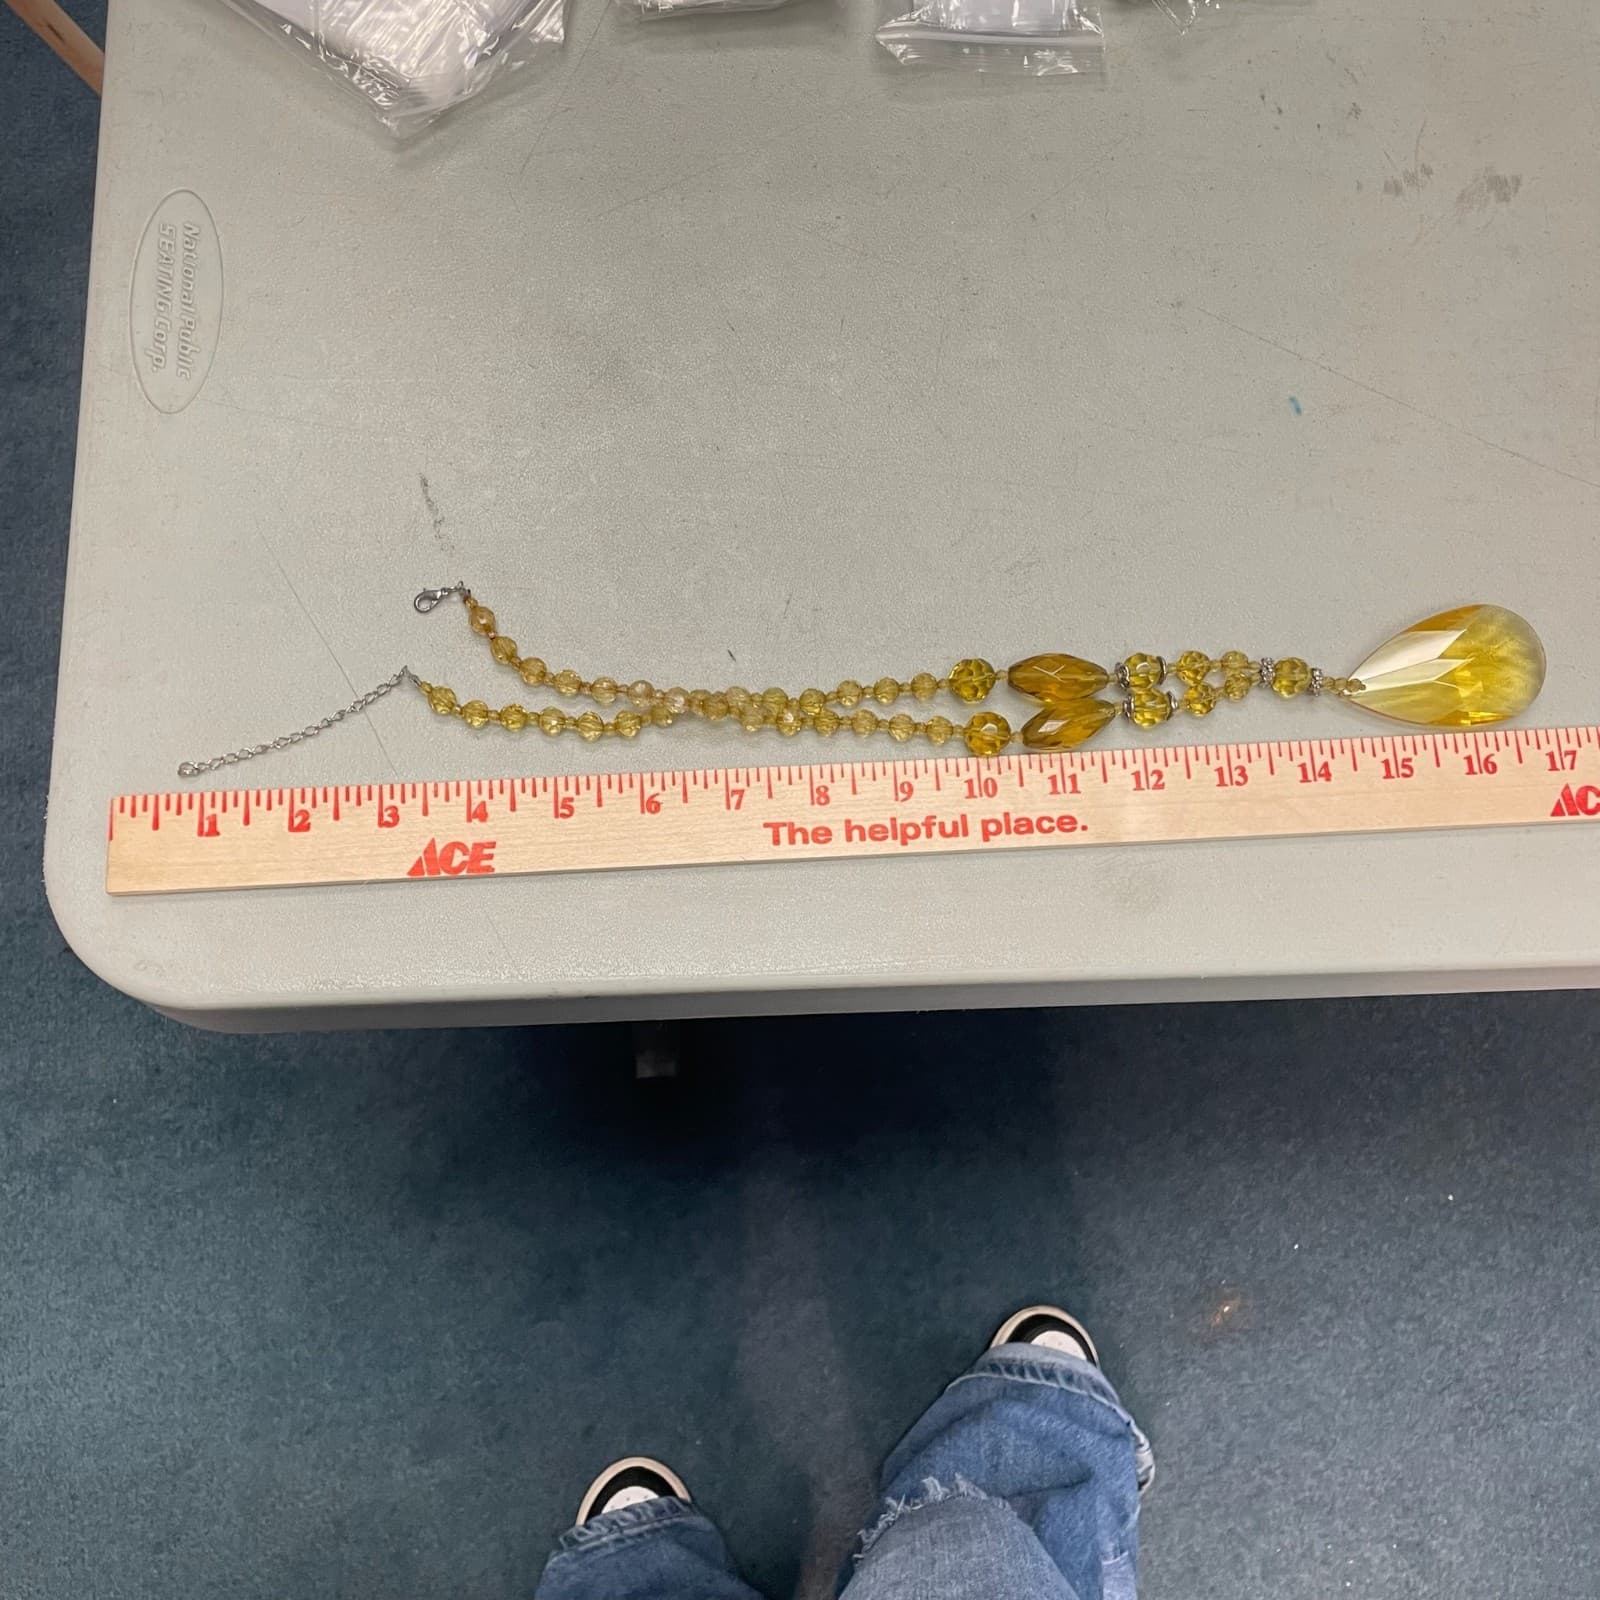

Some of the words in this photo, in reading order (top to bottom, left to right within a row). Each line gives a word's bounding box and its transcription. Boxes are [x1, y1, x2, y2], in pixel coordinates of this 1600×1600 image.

[156, 222, 175, 315] SEATING
[181, 221, 200, 313] National
[146, 316, 171, 373] Corp.
[177, 313, 200, 380] Public
[204, 813, 220, 838] 1
[293, 809, 312, 833] 2
[382, 805, 401, 828] 3
[470, 801, 489, 823] 4
[559, 797, 576, 819] 5
[645, 794, 662, 815] 6
[731, 789, 745, 810] 7
[815, 785, 831, 806] 8
[899, 781, 914, 802] 9
[965, 777, 998, 799] 10
[1048, 773, 1080, 795] 11
[1132, 769, 1166, 791] 12
[1215, 765, 1248, 787] 13
[1298, 762, 1332, 783] 14
[1381, 758, 1414, 779] 15
[1464, 754, 1498, 775] 16
[1546, 750, 1578, 771] 17
[1550, 783, 1600, 817] AC
[407, 838, 496, 878] ACE
[763, 821, 833, 846] The
[844, 813, 970, 847] helpful
[981, 811, 1089, 843] place.
